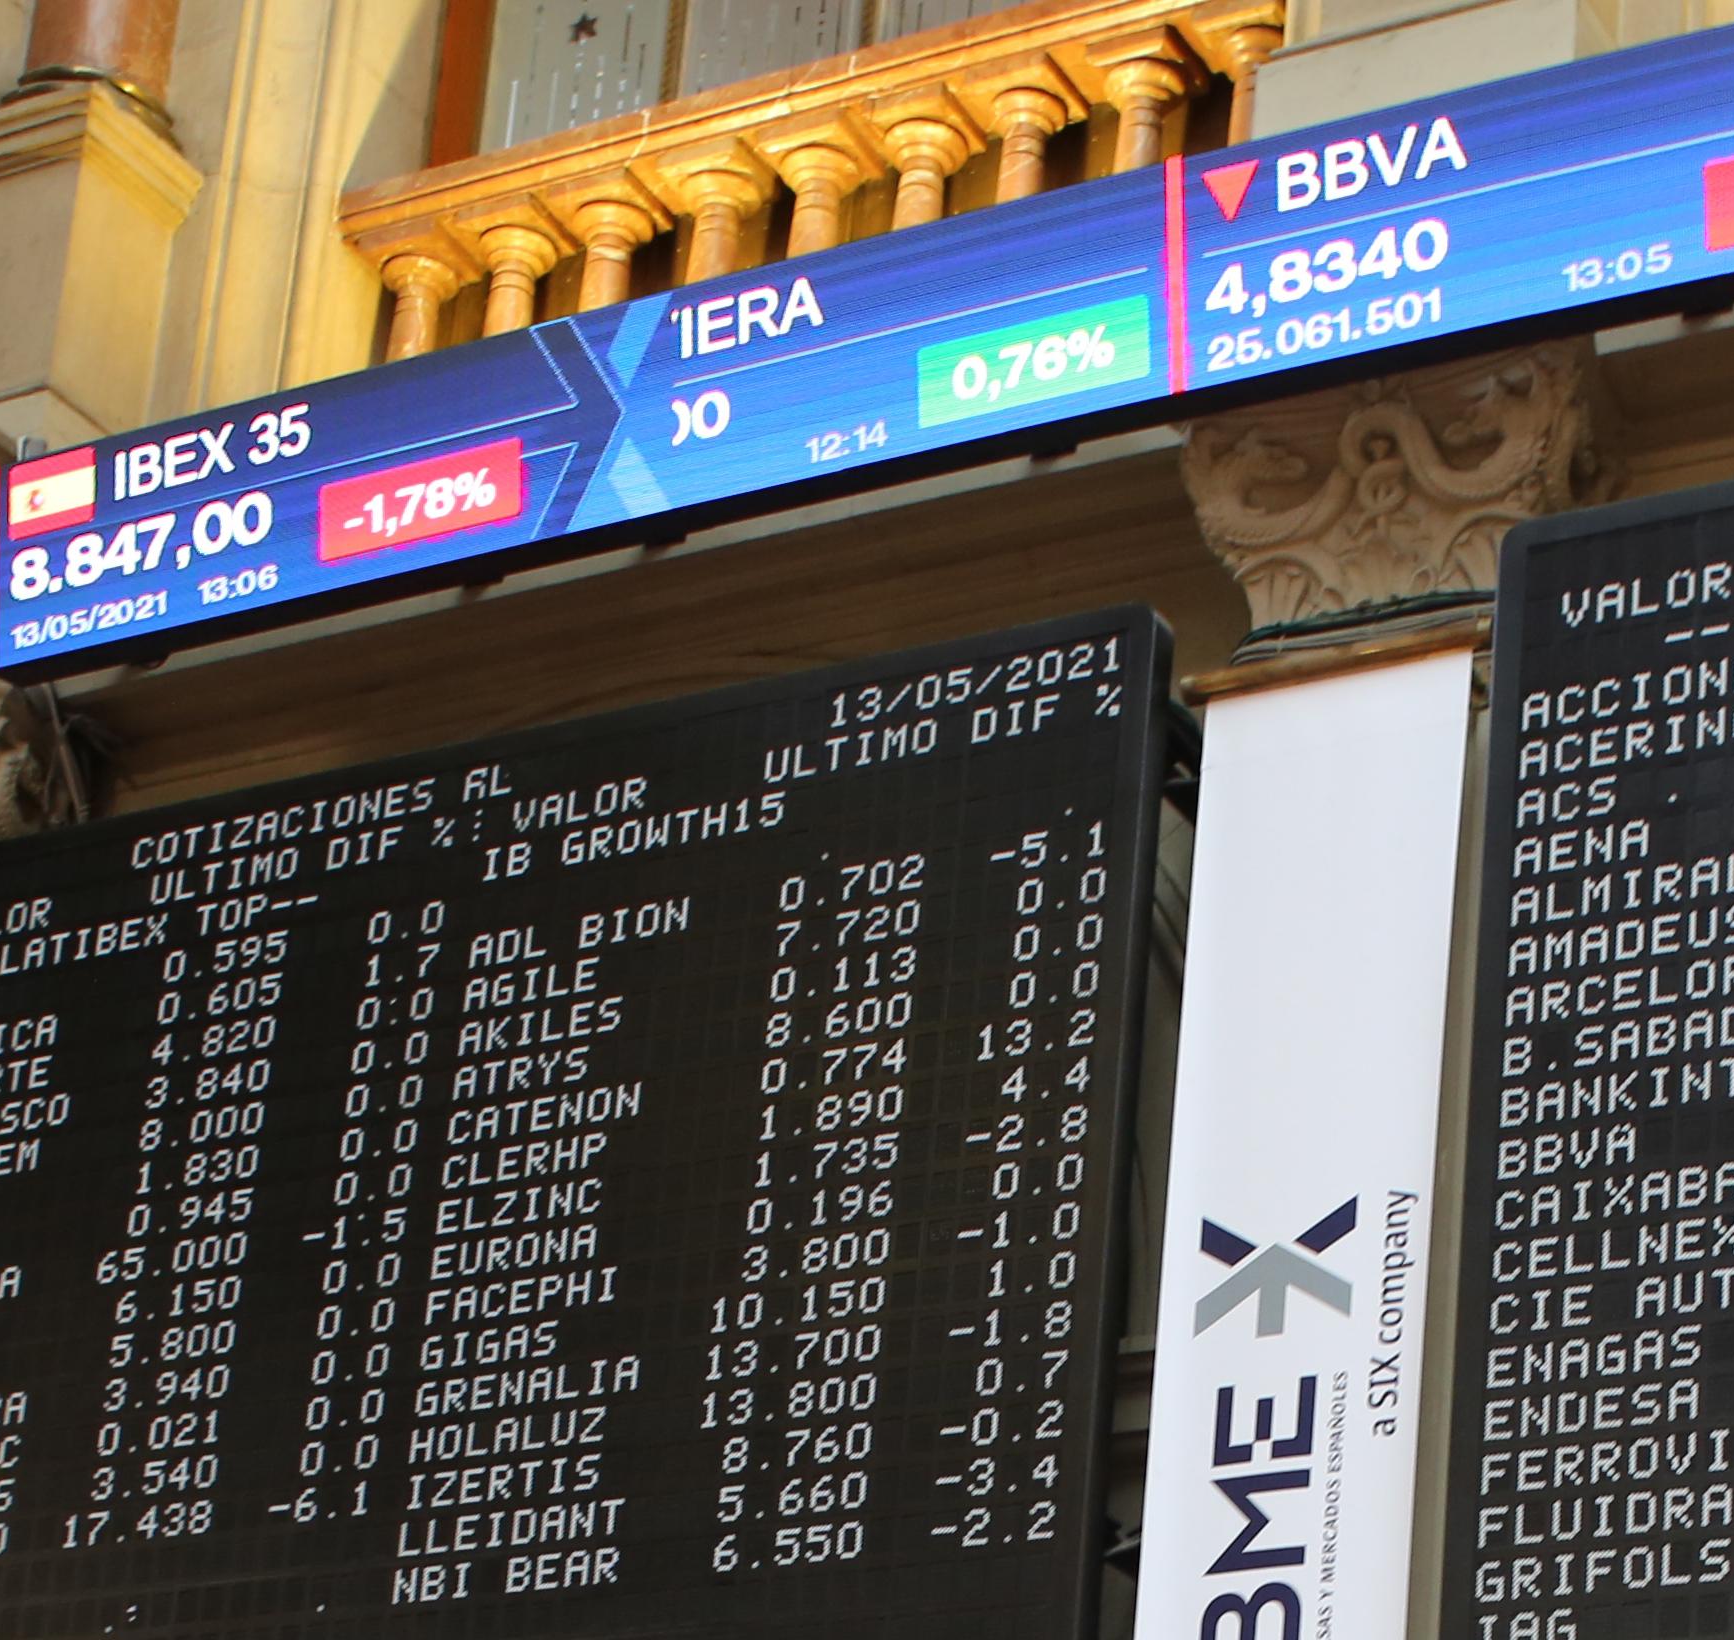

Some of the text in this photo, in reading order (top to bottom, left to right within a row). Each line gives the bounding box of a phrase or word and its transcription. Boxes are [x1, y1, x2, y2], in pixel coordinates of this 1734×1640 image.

[1276, 117, 1468, 214] BBVA
[1205, 218, 1449, 320] 4,8340
[1562, 243, 1674, 292] 13:05
[670, 276, 824, 360] IERA
[1207, 290, 1443, 373] 25.061.501
[950, 324, 1115, 407] 0,76%
[112, 403, 313, 502] IBEX 35
[804, 418, 889, 464] 12:14
[10, 490, 273, 604] 8.847,00
[342, 464, 497, 542] -1,78%
[10, 564, 280, 651] 13/05/2021 13:06
[1560, 561, 1733, 629] VALOR
[830, 636, 1120, 729] 13/05/2021
[512, 683, 1122, 833] VALOR ULTIMO DIF %
[131, 777, 436, 870] COTIZACIONES
[149, 846, 300, 906] ULTIMO
[325, 824, 404, 872] DIF
[431, 816, 456, 848] %
[481, 790, 786, 882] IB GROWTH15
[1512, 818, 1650, 878] AENA
[156, 971, 284, 1026] 0.605
[364, 942, 441, 988] 1.7
[457, 912, 1104, 1057] AKILES 0.113 0.0
[144, 1058, 271, 1110] 3.840
[350, 1030, 430, 1075] 0.0
[452, 959, 1100, 1101] ATRYS 8.600 0.0
[138, 1100, 266, 1153] 8.000
[344, 1073, 424, 1119] 0.0
[446, 1008, 1096, 1146] CATENON 0.774 13.2
[136, 1144, 261, 1196] 1.830
[339, 1118, 419, 1163] 0.0
[441, 1056, 1091, 1191] CLERHP 1.890 4.4
[1496, 1122, 1637, 1181] BBVA
[434, 1104, 1088, 1236] ELZINC 1.735 -2.8
[429, 1152, 1085, 1281] EURONA 0.196 0.0
[114, 1274, 243, 1325] 6.150
[321, 1251, 402, 1296] 0.0
[1367, 1189, 1420, 1437] a SIX company
[108, 1319, 237, 1369] 5.800
[316, 1296, 396, 1341] 0.0
[414, 1299, 1073, 1418] GRENALIA 13.700 -1.8
[102, 1363, 231, 1413] 3.940
[310, 1342, 391, 1386] 0.0
[1482, 1377, 1700, 1442] ENDESA
[1326, 1370, 1349, 1475] ESPAÑOLES
[89, 1453, 219, 1502] 3.540
[298, 1433, 380, 1477] 0.0
[397, 1454, 1060, 1558] LLEIDANT 5.660 -3.4
[1320, 1477, 1342, 1583] MERCADOS
[1318, 1588, 1334, 1602] Y
